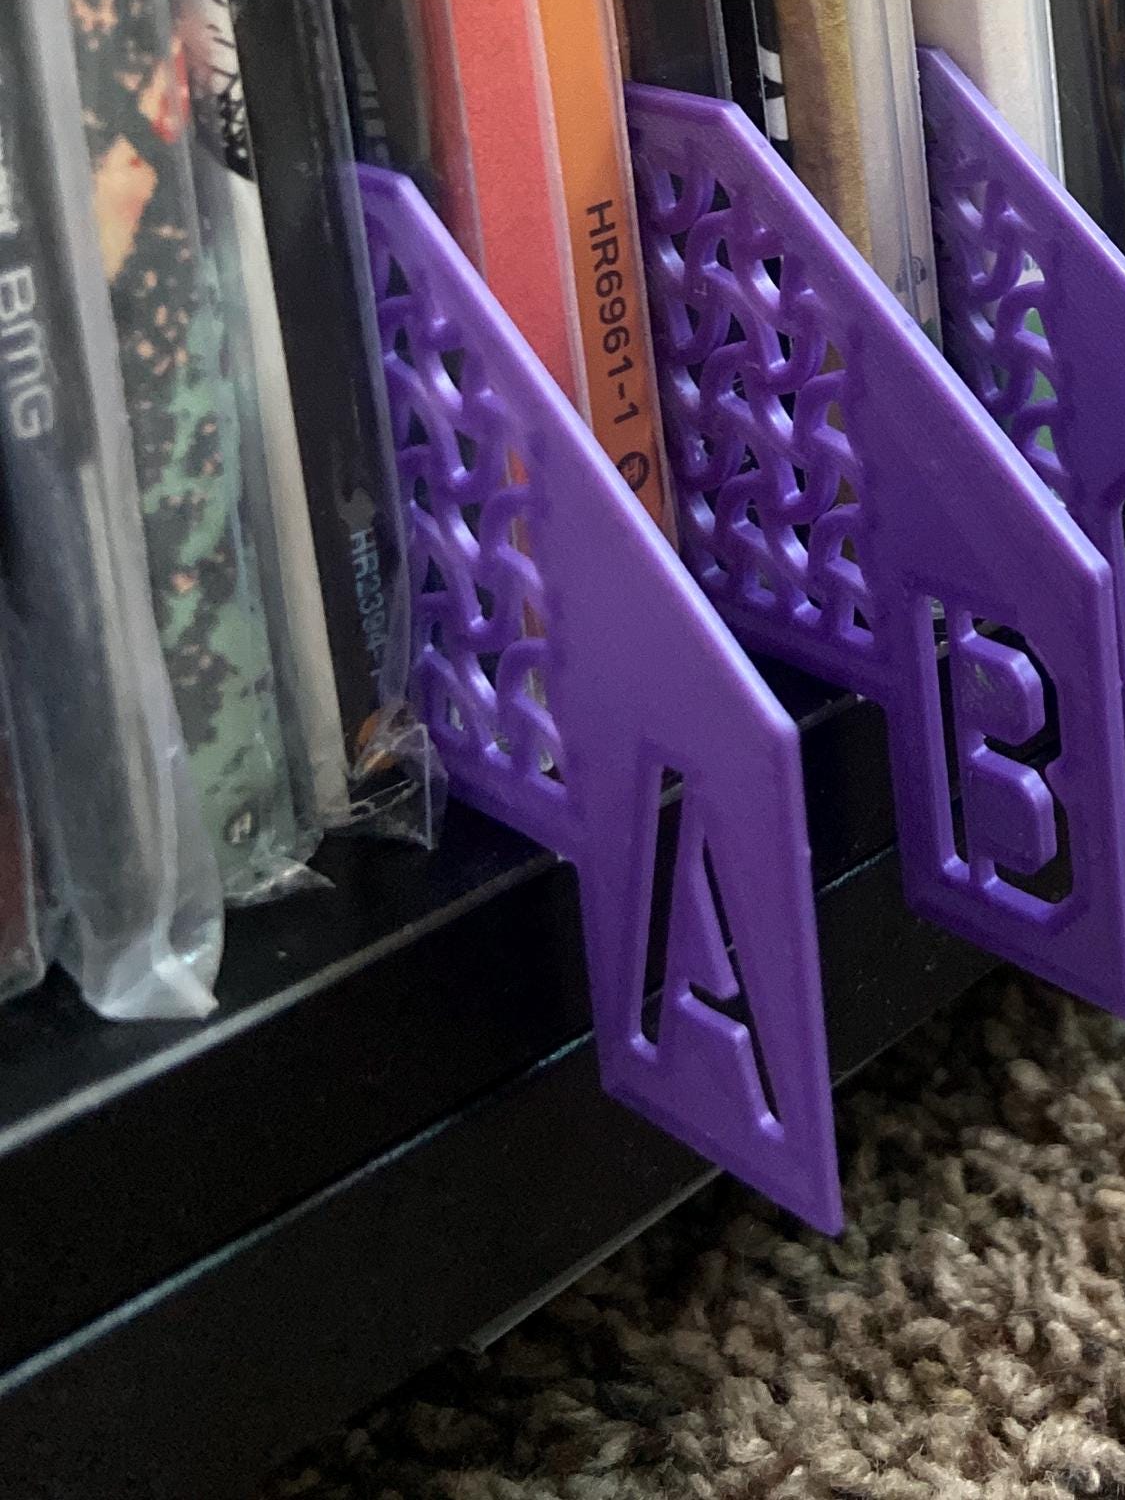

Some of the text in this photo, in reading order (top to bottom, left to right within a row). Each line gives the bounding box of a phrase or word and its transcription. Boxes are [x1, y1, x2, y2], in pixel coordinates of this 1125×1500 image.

[585, 199, 641, 425] HR6961-1
[924, 593, 1076, 924] B
[629, 764, 785, 1143] A
